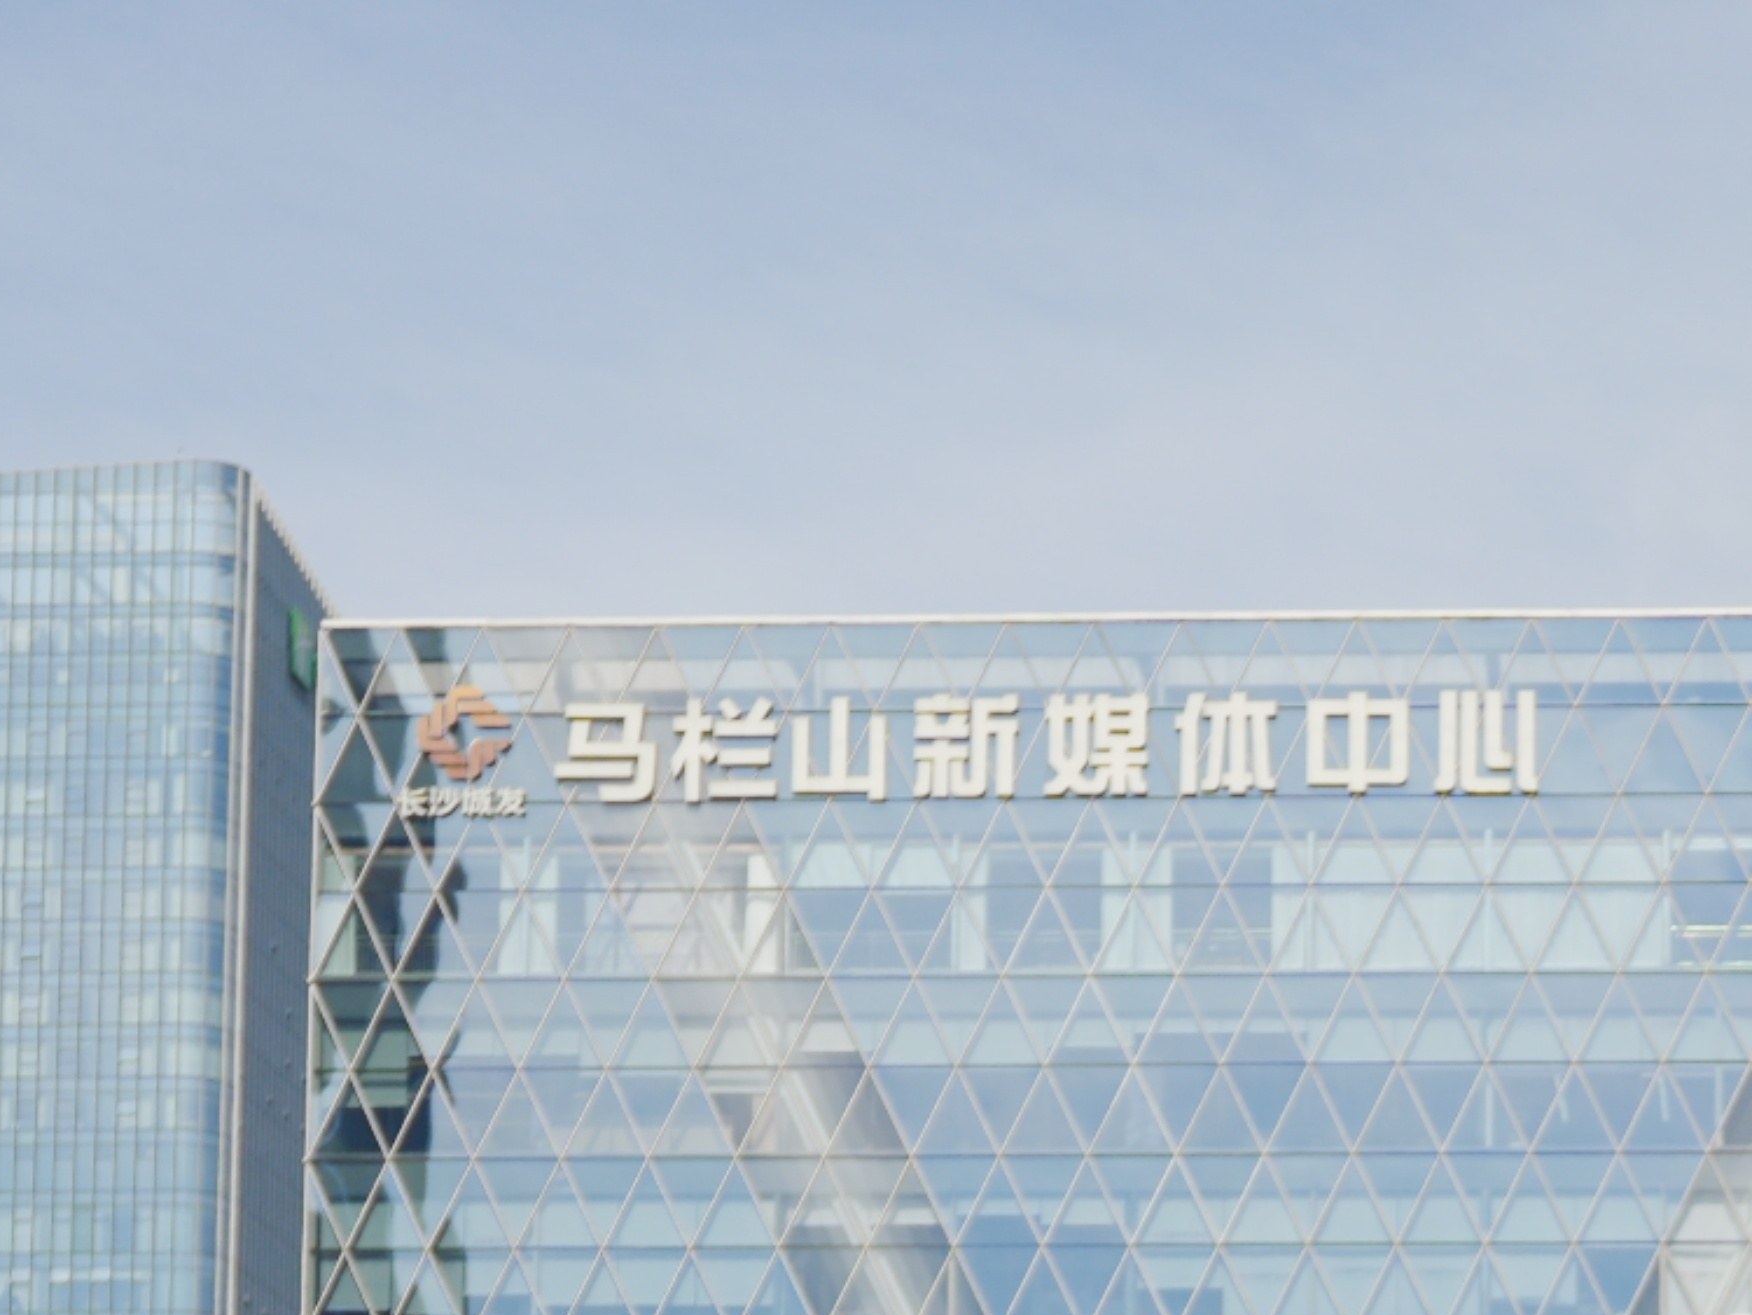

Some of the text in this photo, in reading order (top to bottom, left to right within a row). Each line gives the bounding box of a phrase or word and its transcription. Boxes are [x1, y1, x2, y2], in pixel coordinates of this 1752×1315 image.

[554, 689, 1539, 803] 马栏山新媒体中心
[398, 786, 527, 818] 长沙城发
